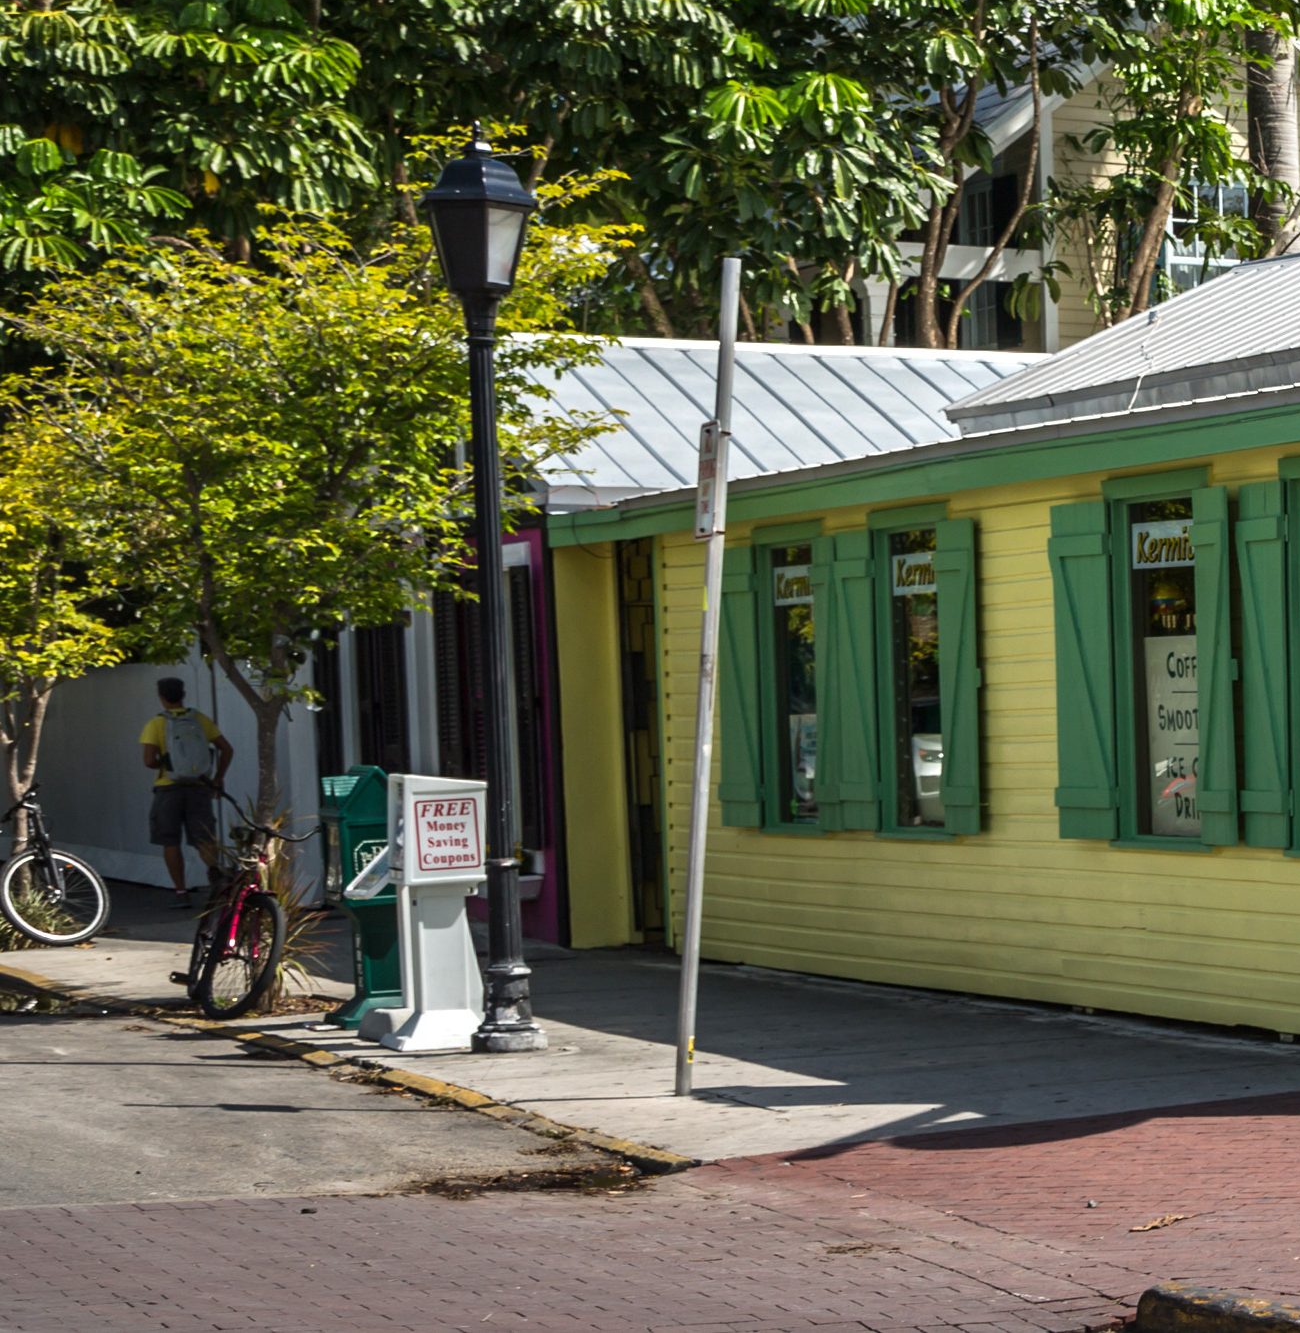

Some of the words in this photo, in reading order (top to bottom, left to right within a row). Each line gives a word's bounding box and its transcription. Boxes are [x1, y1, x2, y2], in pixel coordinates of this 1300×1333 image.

[1167, 651, 1197, 680] COFF
[420, 801, 472, 818] FREE
[426, 820, 467, 833] Money
[427, 836, 469, 849] Saving
[423, 852, 476, 866] Coupons
